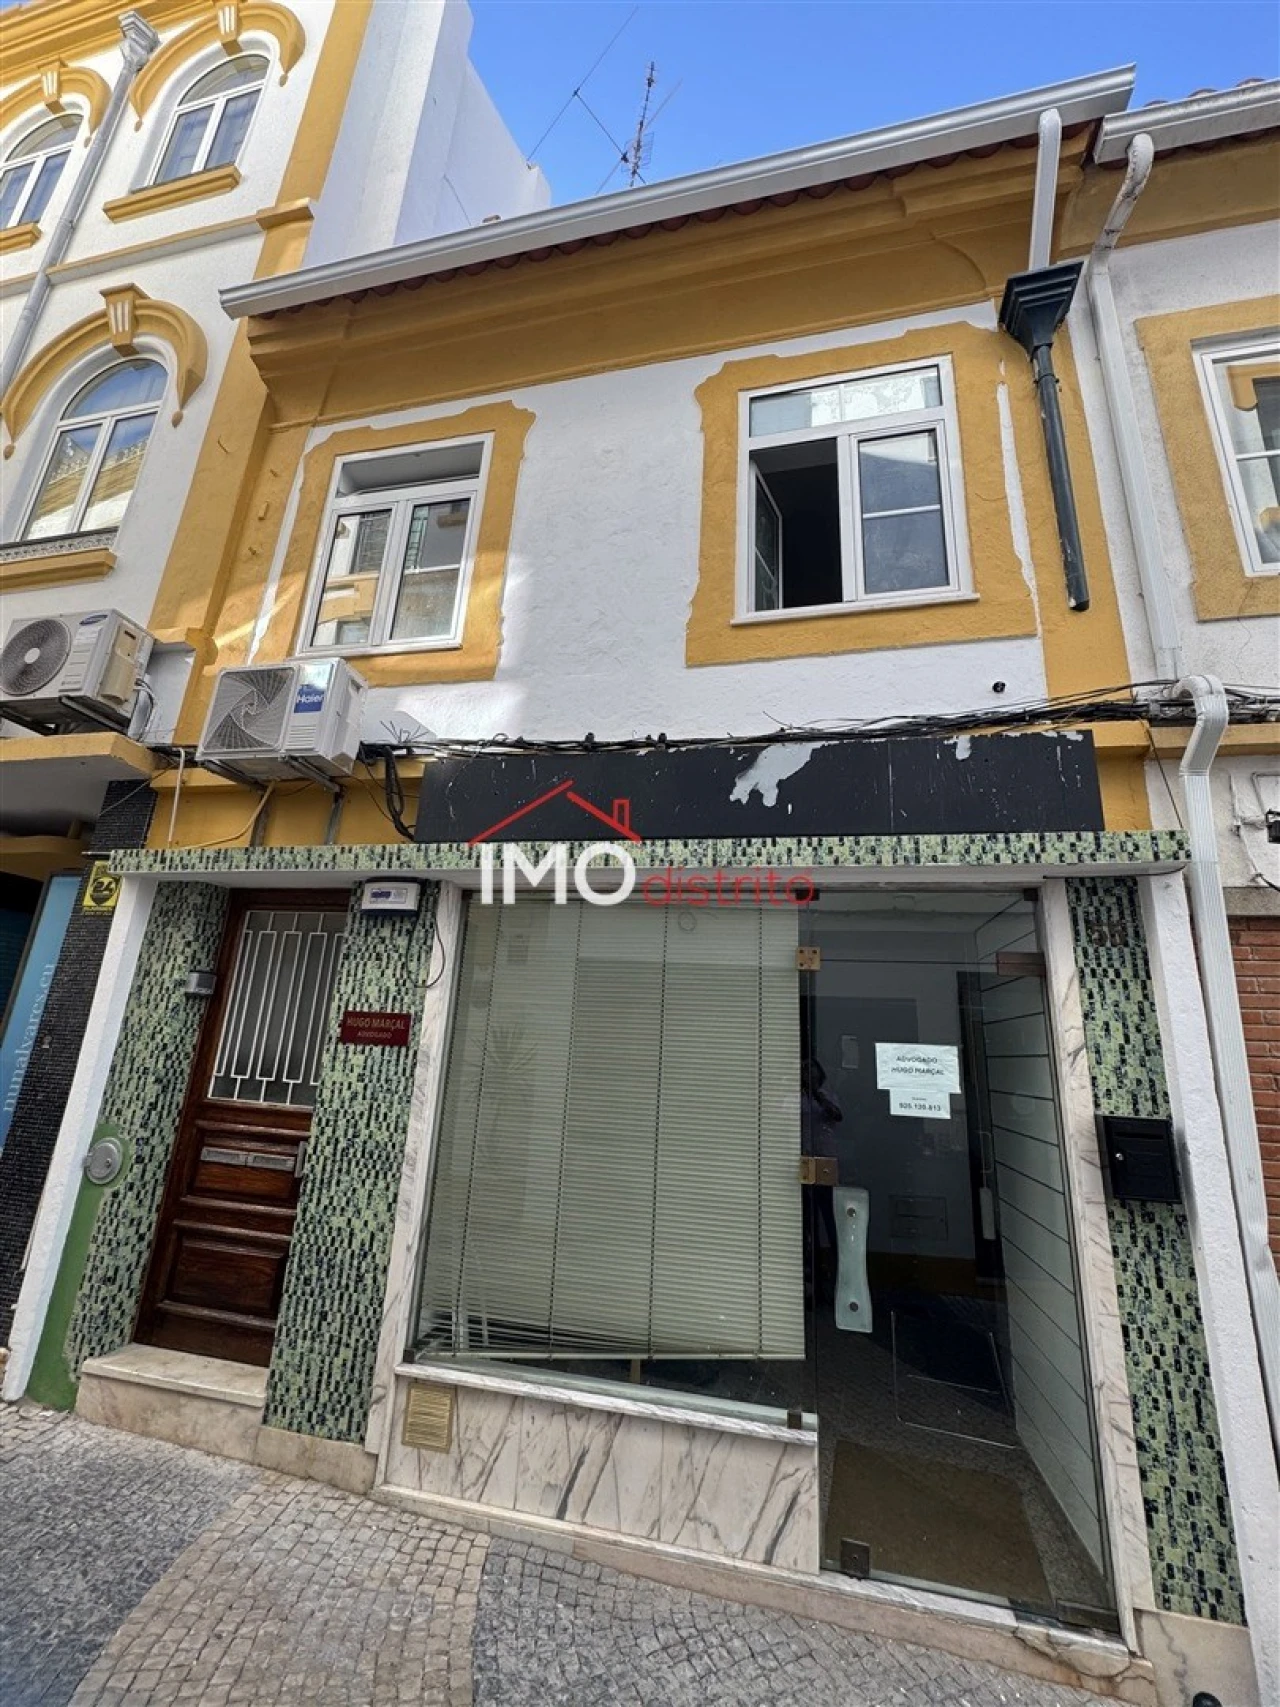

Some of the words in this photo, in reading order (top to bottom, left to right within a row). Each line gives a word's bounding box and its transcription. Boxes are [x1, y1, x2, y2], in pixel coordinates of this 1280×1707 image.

[296, 692, 324, 703] Haier
[346, 1016, 371, 1028] HUGO
[371, 1018, 406, 1031] MARÇAL
[896, 1055, 938, 1064] ADVOGADO
[890, 1066, 914, 1075] HUGO
[914, 1067, 946, 1077] MARÇAL
